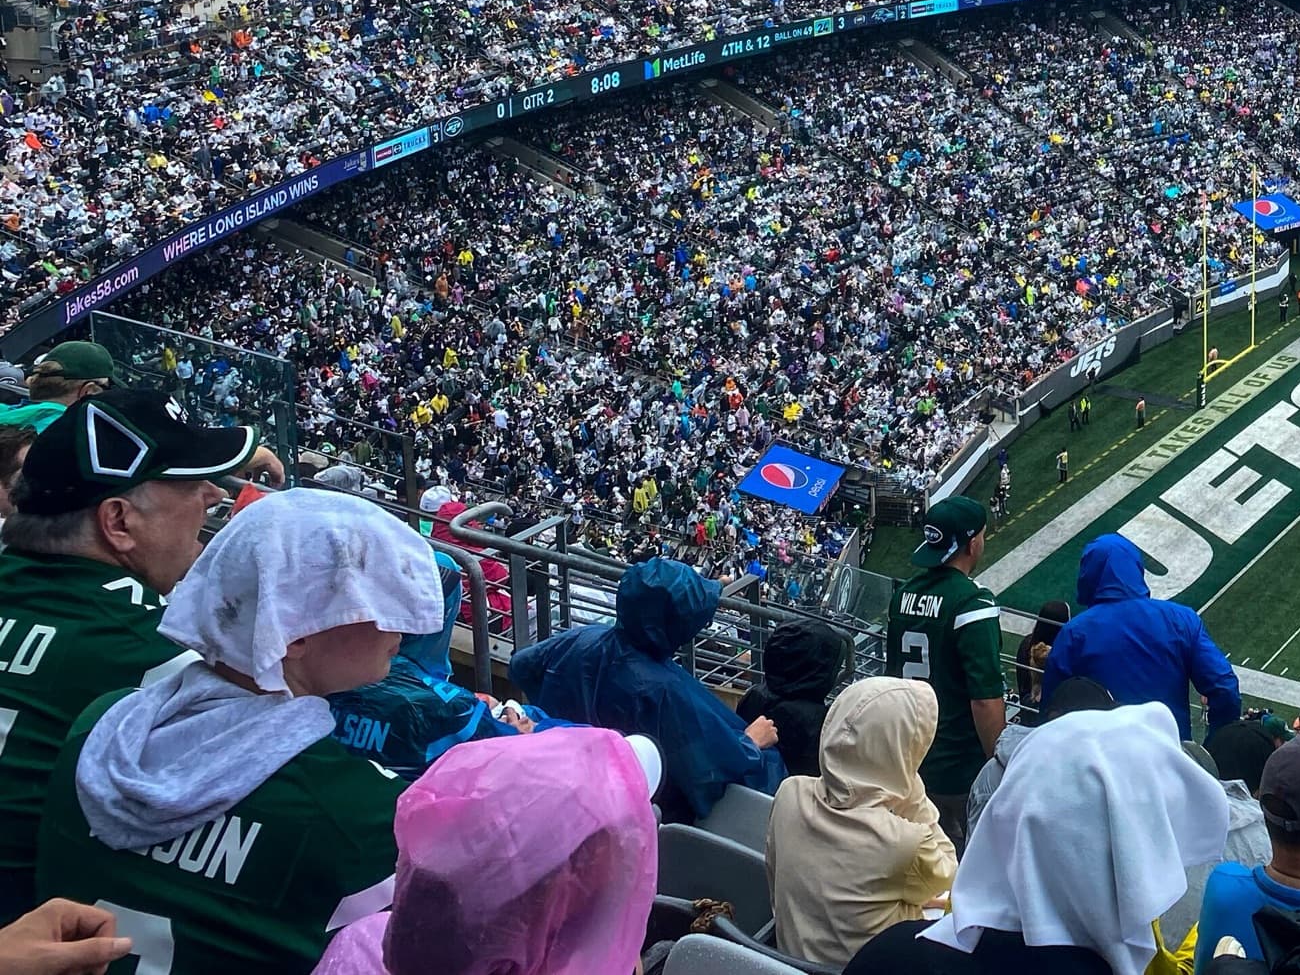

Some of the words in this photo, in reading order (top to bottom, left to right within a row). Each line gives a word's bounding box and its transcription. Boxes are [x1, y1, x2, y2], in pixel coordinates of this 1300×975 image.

[774, 30, 792, 41] BALL
[793, 28, 802, 39] ON
[803, 26, 813, 36] 49
[838, 18, 845, 30] 3
[721, 41, 743, 57] 4TH
[745, 39, 754, 50] &
[756, 36, 770, 49] 12
[663, 50, 706, 73] MetLife
[591, 72, 620, 94] 8:08
[497, 102, 504, 118] 0
[523, 92, 544, 110] QTR
[547, 89, 554, 103] 2
[433, 133, 439, 143] 3
[163, 227, 206, 262] WHERE
[208, 210, 243, 237] LONG
[245, 191, 288, 221] ISLAND
[289, 175, 319, 200] WINS
[65, 266, 138, 324] jakes58.com
[1070, 335, 1117, 378] JETS
[1122, 463, 1154, 480] IT
[1146, 416, 1215, 460] TAKES
[1210, 392, 1251, 415] ALL
[1243, 372, 1273, 388] OF
[1276, 355, 1298, 371] US
[808, 478, 827, 498] pepsi
[900, 592, 944, 618] WILSON
[901, 631, 931, 680] 2
